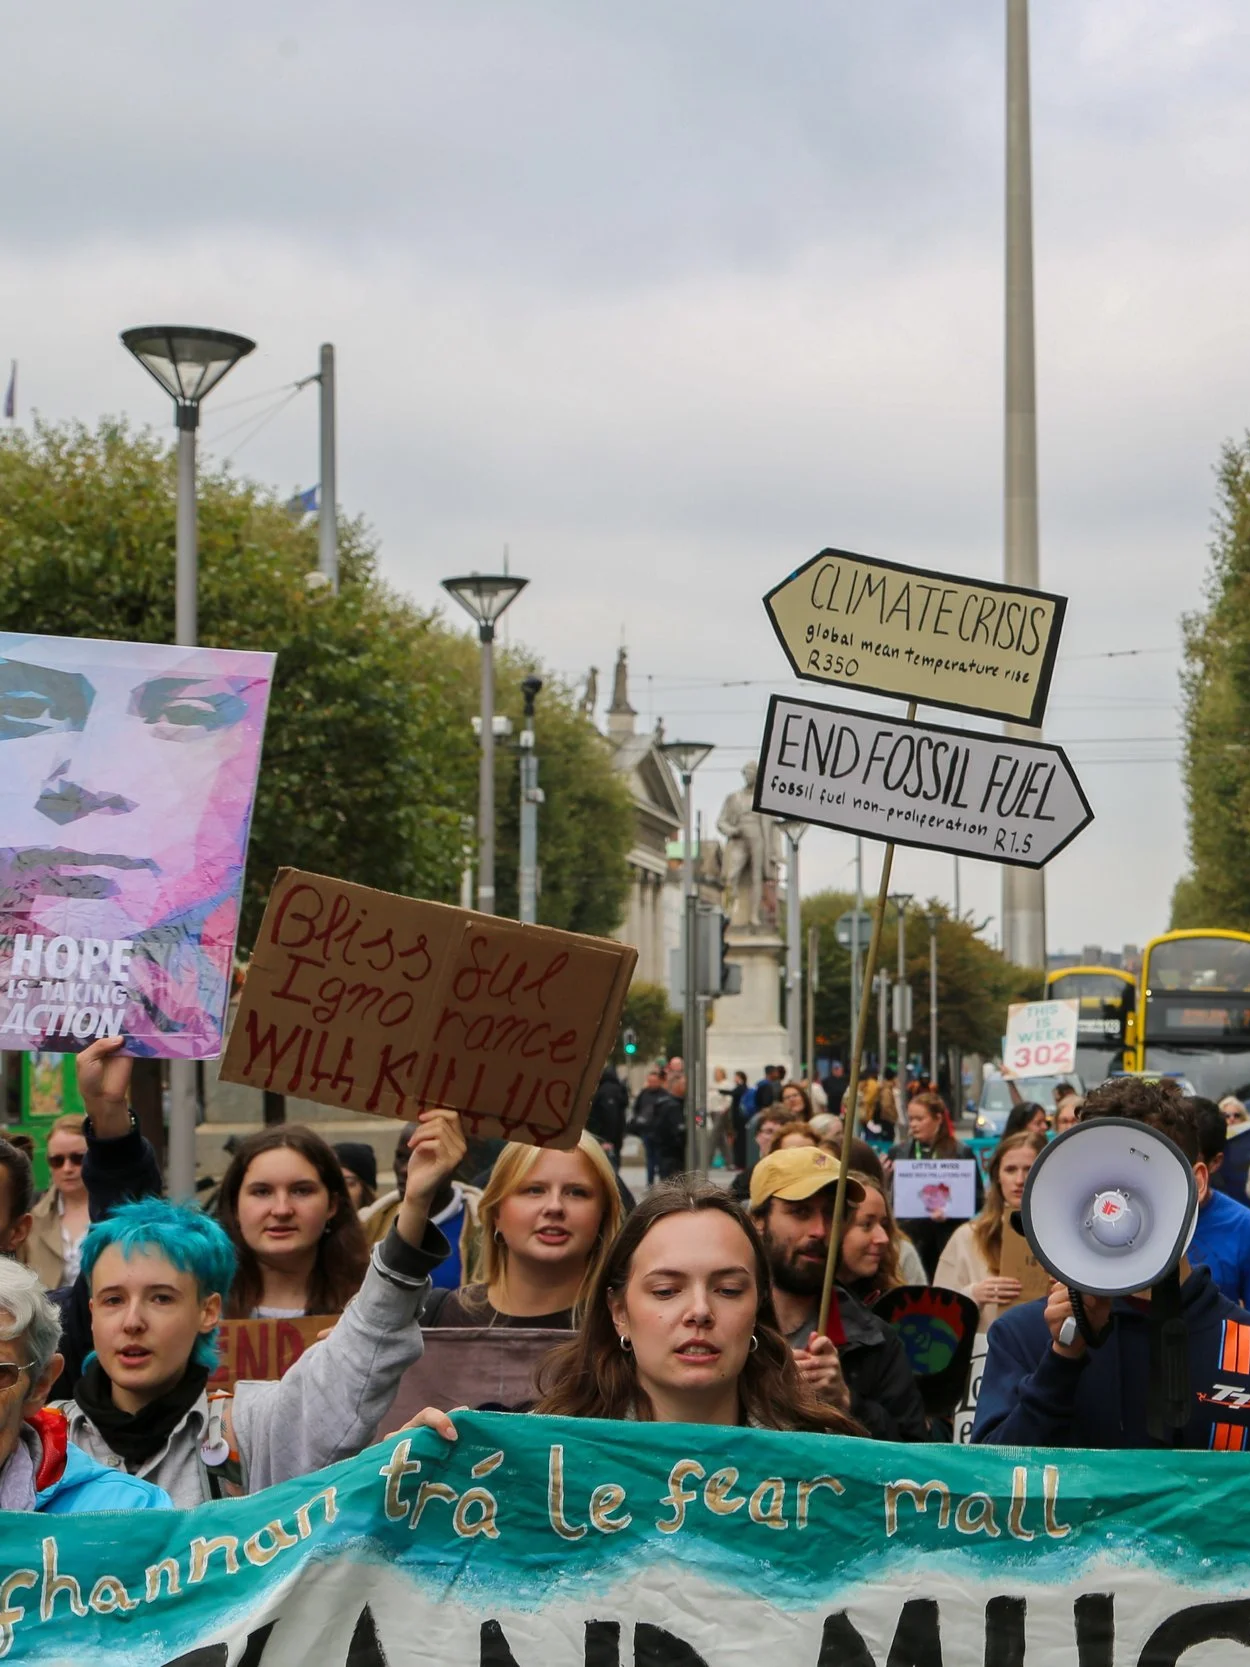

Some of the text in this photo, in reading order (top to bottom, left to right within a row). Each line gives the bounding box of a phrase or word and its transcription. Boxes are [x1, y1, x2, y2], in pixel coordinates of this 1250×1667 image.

[811, 563, 1046, 656] CLIMATE CRISIS
[804, 624, 1030, 684] global mean temperature rise
[808, 650, 859, 677] R350
[778, 714, 1056, 822] END FOSSIL FUEL
[771, 776, 1033, 854] fossil fuel non-proliferation R1.5
[10, 933, 134, 981] HOPE
[271, 884, 432, 982] Bliss
[8, 979, 128, 1005] IS TAKING
[271, 953, 577, 1063] Igno rance
[1027, 1005, 1059, 1017] THIS
[0, 1003, 126, 1038] ACTION
[1017, 1028, 1067, 1042] WEEK
[1036, 1018, 1051, 1028] IS
[243, 1009, 573, 1147] WILL KILL US
[1014, 1042, 1072, 1068] 302
[912, 1162, 937, 1170] LITTLE
[0, 1486, 340, 1659] fhannan
[379, 1438, 504, 1540] trá
[548, 1444, 633, 1541] le
[656, 1458, 846, 1534] fear
[884, 1464, 1074, 1543] mall
